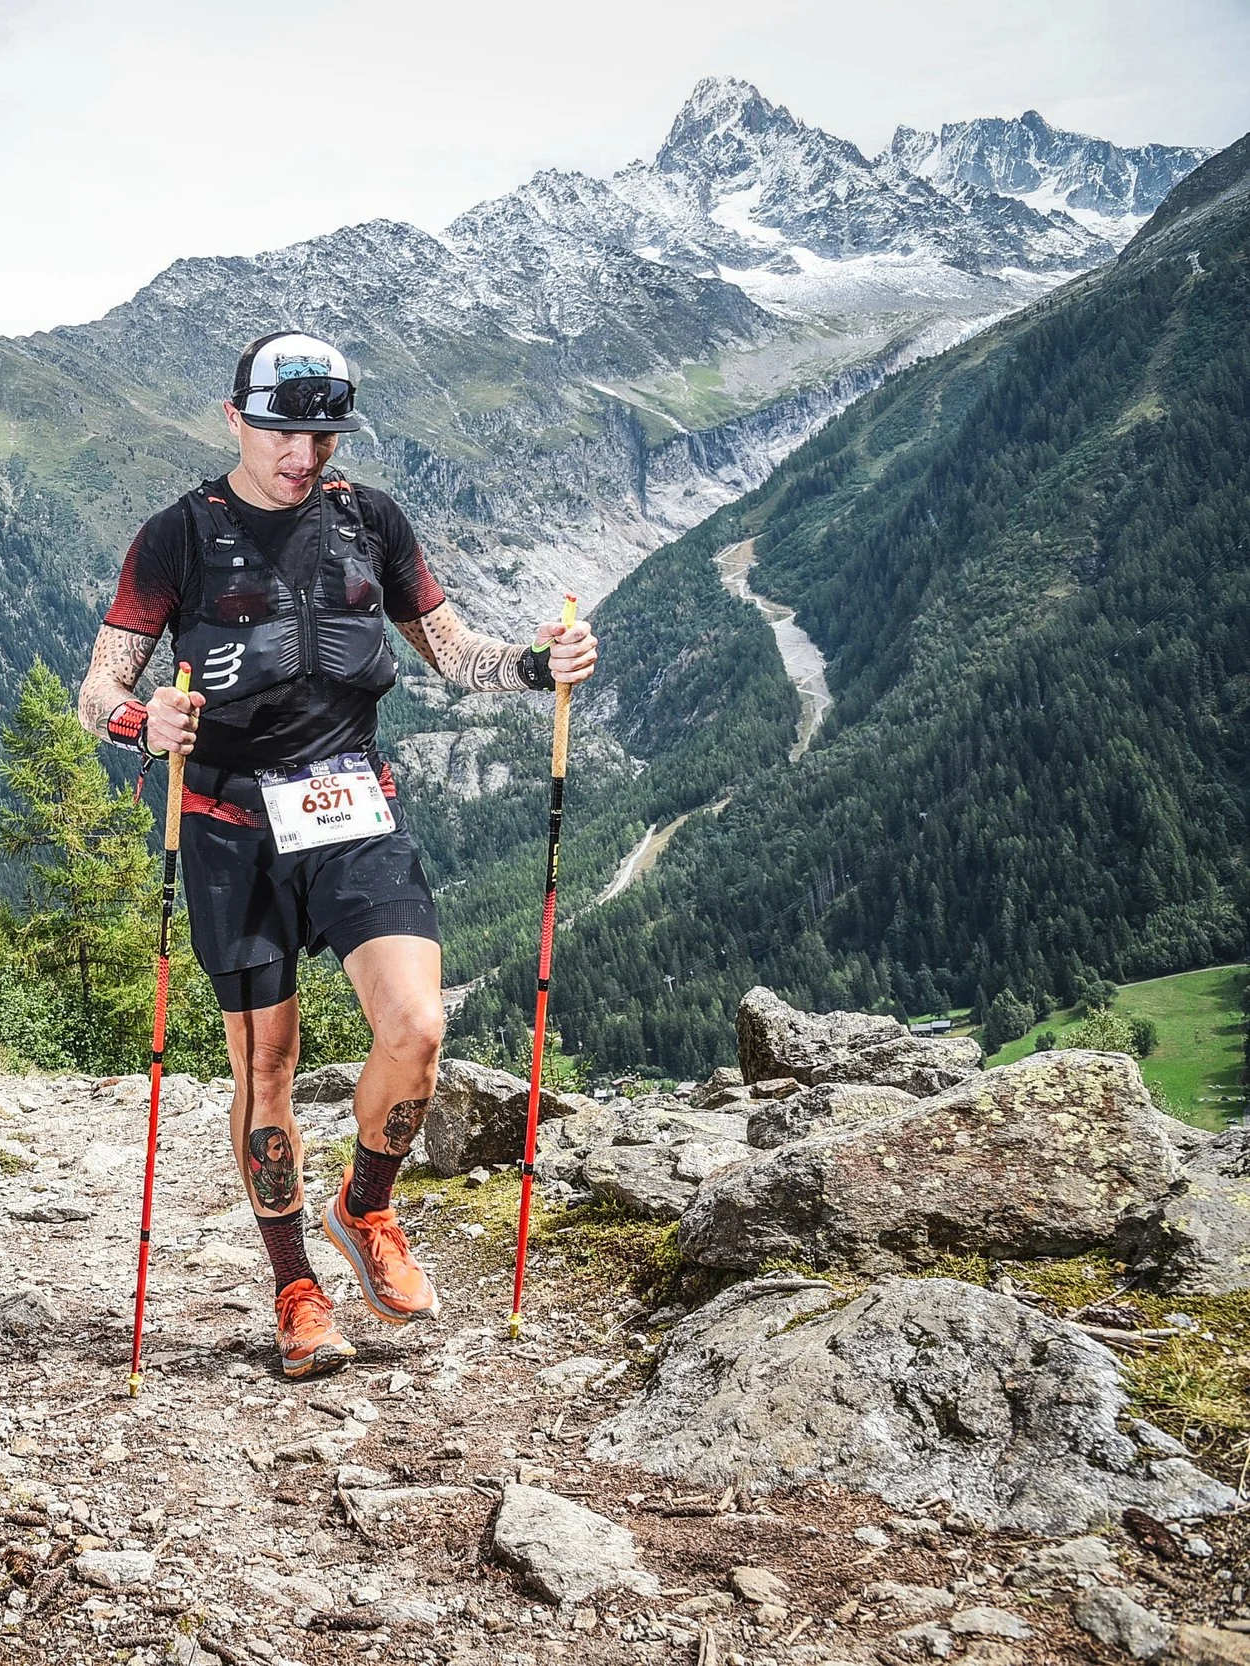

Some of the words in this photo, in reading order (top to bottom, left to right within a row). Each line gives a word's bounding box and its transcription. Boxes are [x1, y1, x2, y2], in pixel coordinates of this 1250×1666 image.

[310, 777, 339, 790] OCC
[302, 788, 353, 813] 6371
[316, 811, 351, 826] Nicola
[551, 843, 559, 882] LEKI
